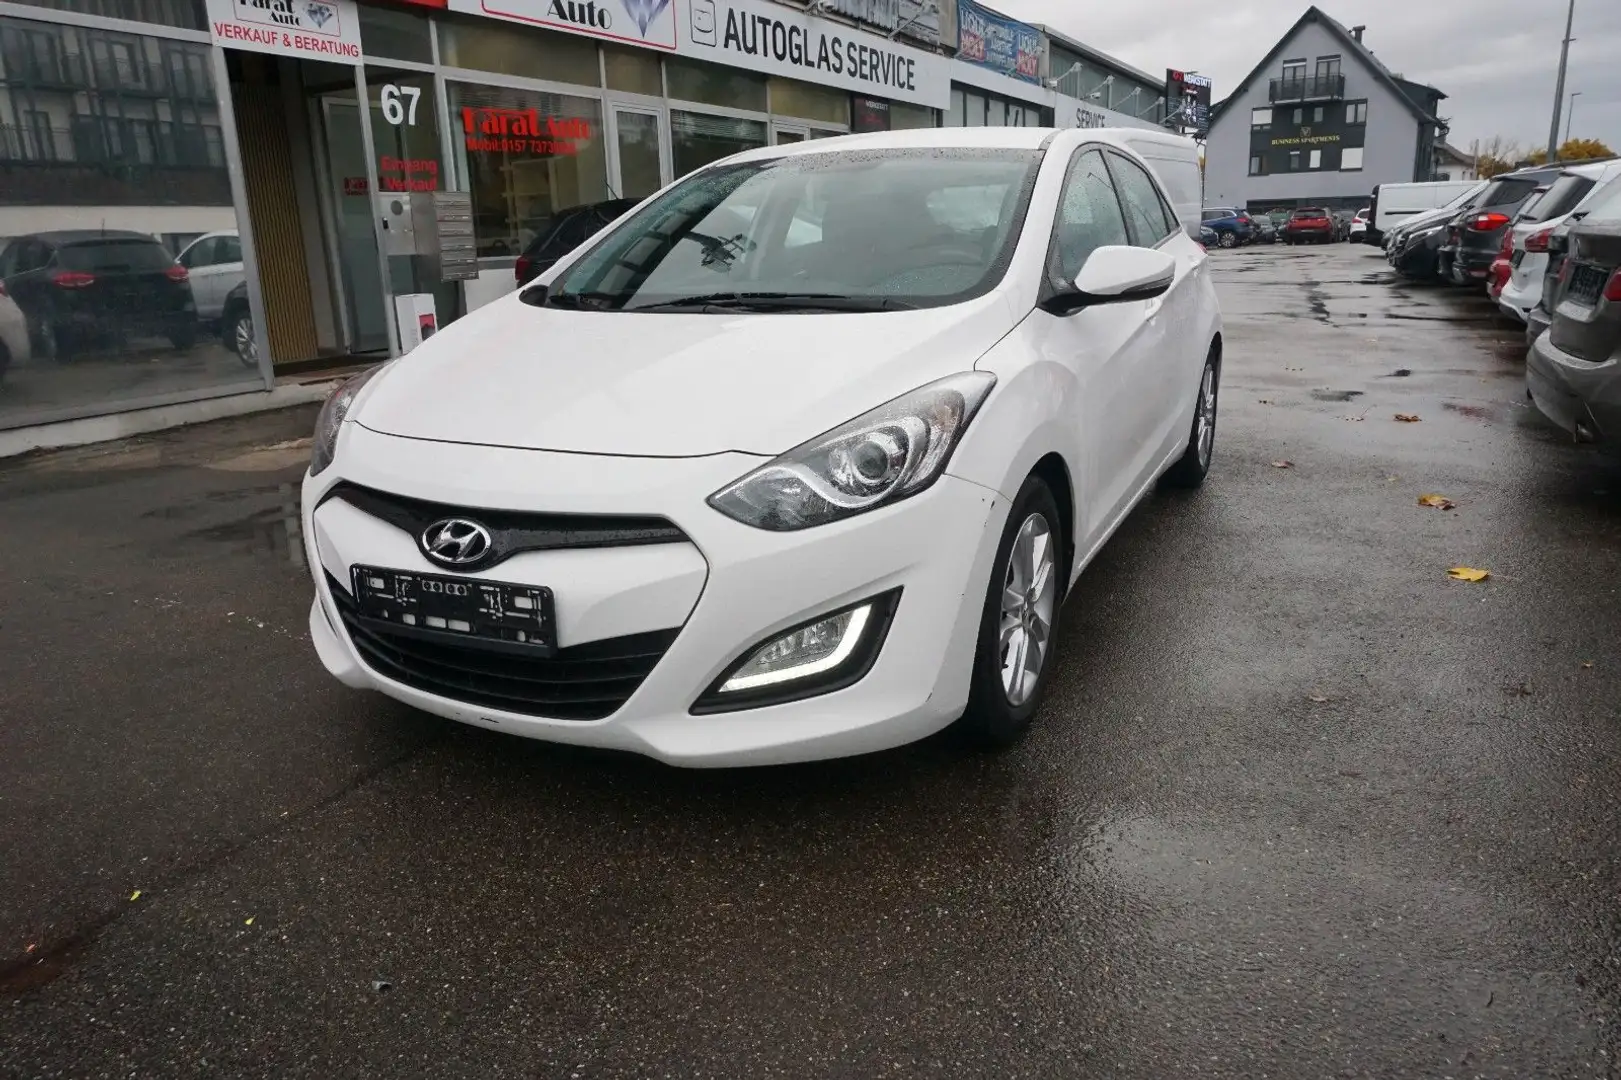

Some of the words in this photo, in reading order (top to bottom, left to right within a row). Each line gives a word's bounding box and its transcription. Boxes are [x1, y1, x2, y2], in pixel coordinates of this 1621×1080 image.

[269, 11, 301, 27] Auto
[547, 0, 613, 30] Auto
[214, 22, 278, 45] VERKAUF
[282, 33, 292, 48] &
[295, 35, 359, 58] BERATUNG
[724, 8, 843, 74] AUTOGLAS
[847, 42, 916, 91] SERVICE
[381, 84, 421, 125] 67
[1271, 137, 1300, 146] BUSINESS
